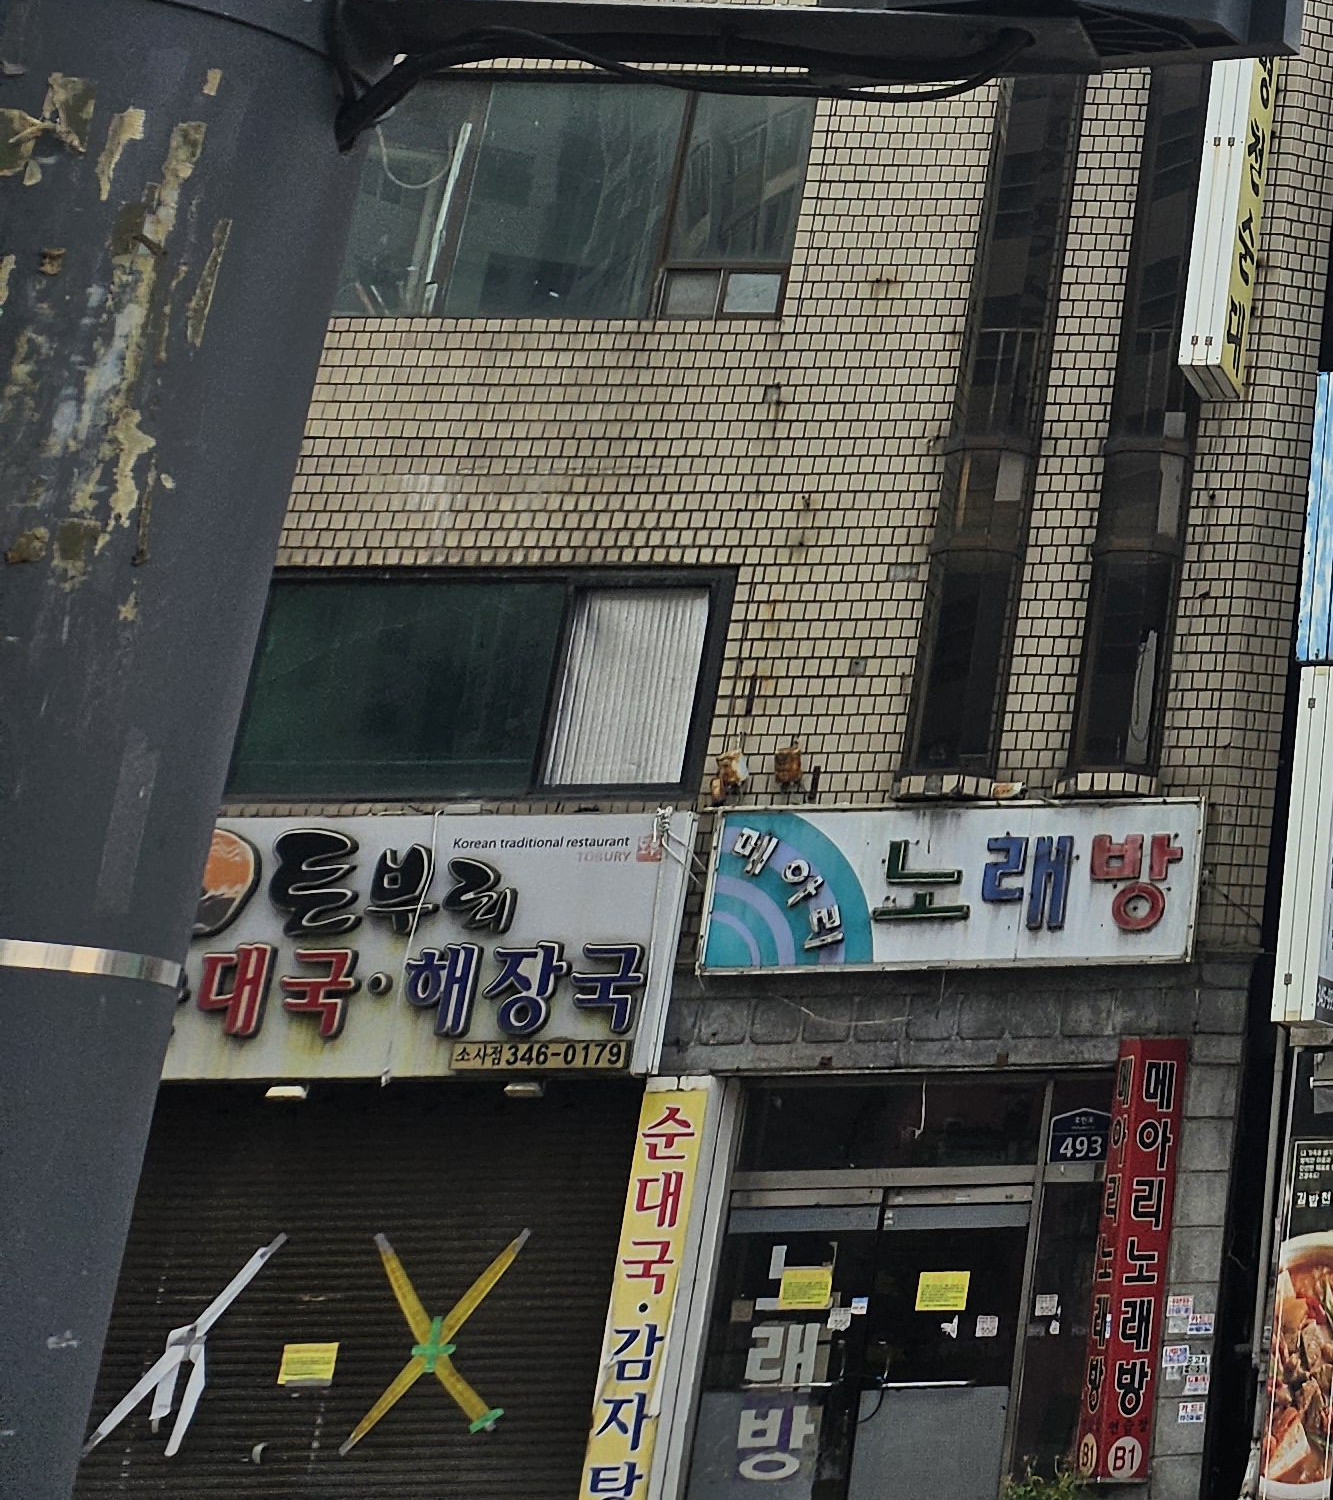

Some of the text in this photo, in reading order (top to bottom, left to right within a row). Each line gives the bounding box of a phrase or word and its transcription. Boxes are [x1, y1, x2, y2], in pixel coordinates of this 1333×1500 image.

[453, 836, 497, 849] Korean
[500, 836, 563, 849] traditional
[566, 835, 629, 848] restaurant
[872, 833, 1184, 931] 노래방
[180, 942, 646, 1037] 대국·해장국
[453, 1043, 622, 1066] 소사점 346-0179
[1060, 1136, 1102, 1158] 493
[1112, 1444, 1136, 1471] B1
